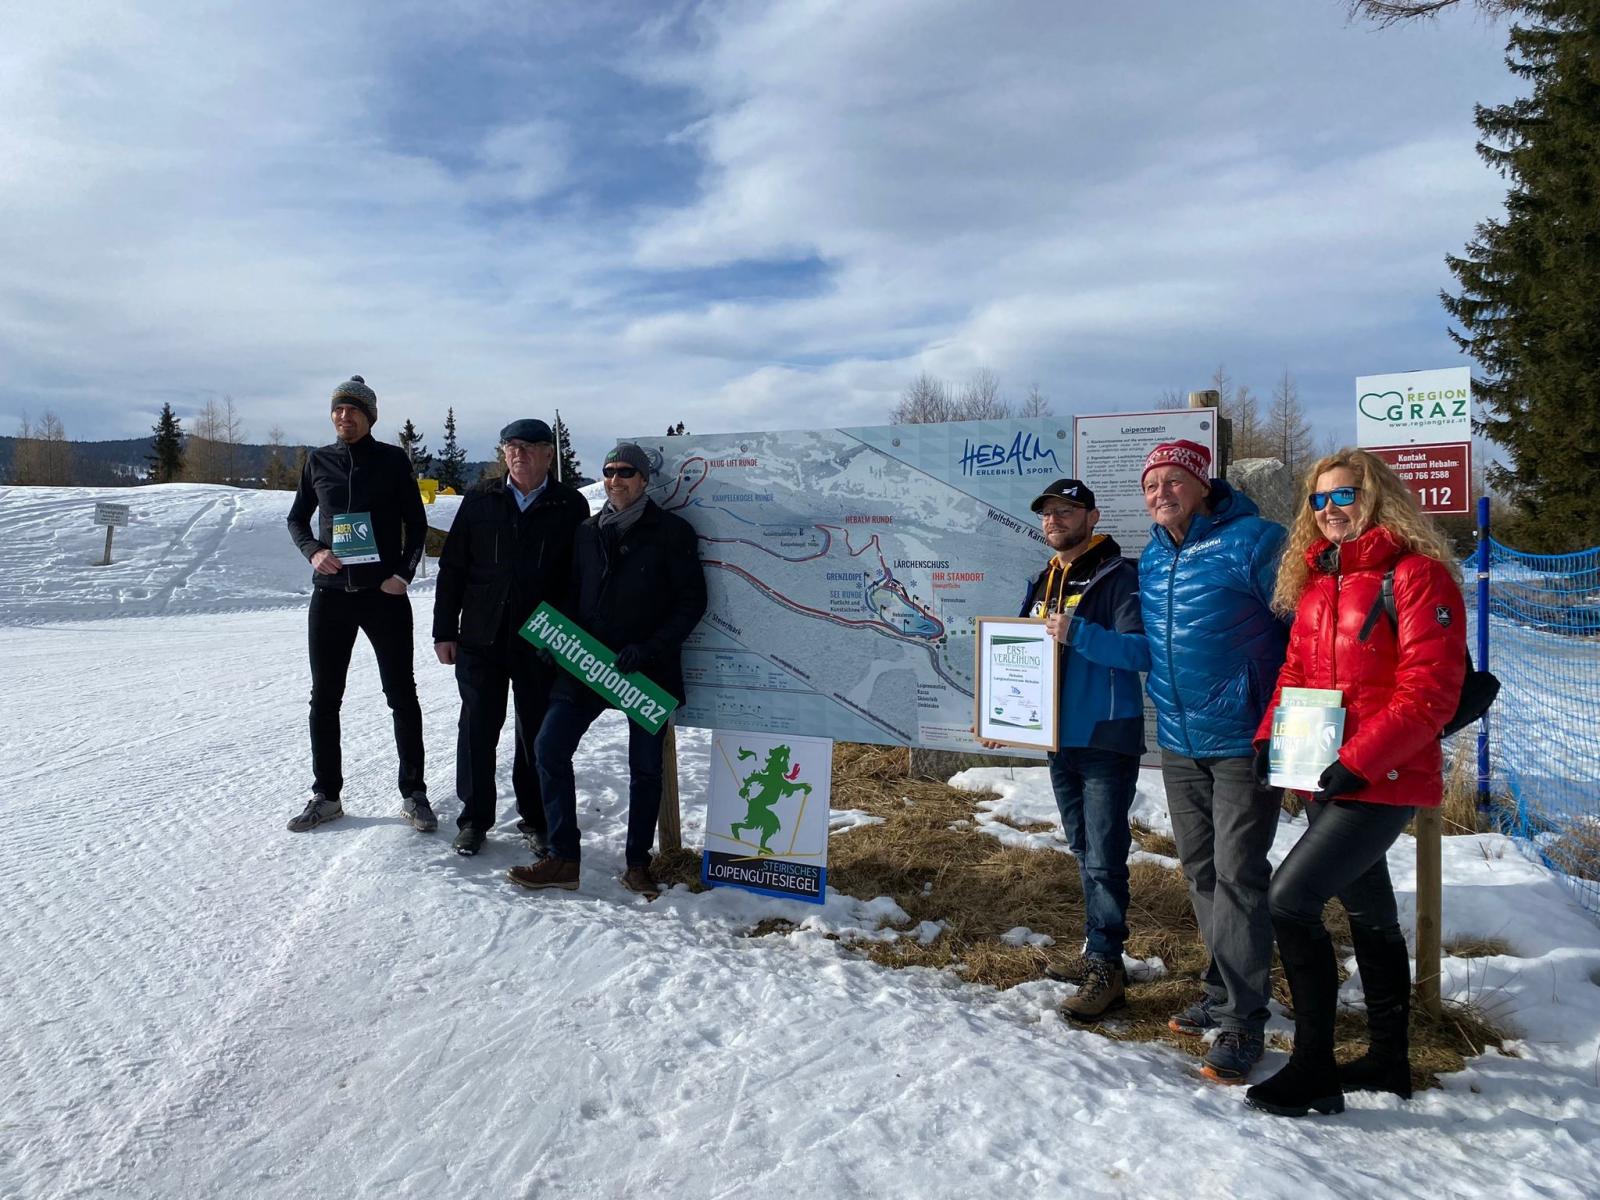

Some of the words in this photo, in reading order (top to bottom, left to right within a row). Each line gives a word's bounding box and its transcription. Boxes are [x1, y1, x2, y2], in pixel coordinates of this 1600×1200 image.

[1407, 389, 1467, 402] REGION
[1387, 400, 1466, 421] GRAZ
[1389, 418, 1467, 428] www.regiongraz.at
[1121, 425, 1166, 434] Loipenregeln
[739, 458, 758, 467] RUNDE
[1429, 460, 1460, 468] Hebalm:
[1418, 487, 1451, 506] 112
[845, 516, 870, 524] HEBALM
[872, 516, 893, 524] RUNDE
[987, 508, 1022, 534] Wolfsberg
[893, 560, 950, 569] LÄRCHENSCHUSS
[826, 573, 862, 581] GRENZLOIPE
[932, 573, 945, 581] IHR
[948, 572, 985, 582] STANDORT
[711, 613, 743, 636] Steiermark
[1007, 645, 1028, 655] ERST-
[993, 653, 1040, 666] VERLEIHUNG
[527, 611, 667, 725] #visitregiongraz
[763, 860, 817, 878] STEIRISCHES
[708, 863, 819, 892] LOIPENGÜTESIEGEL
